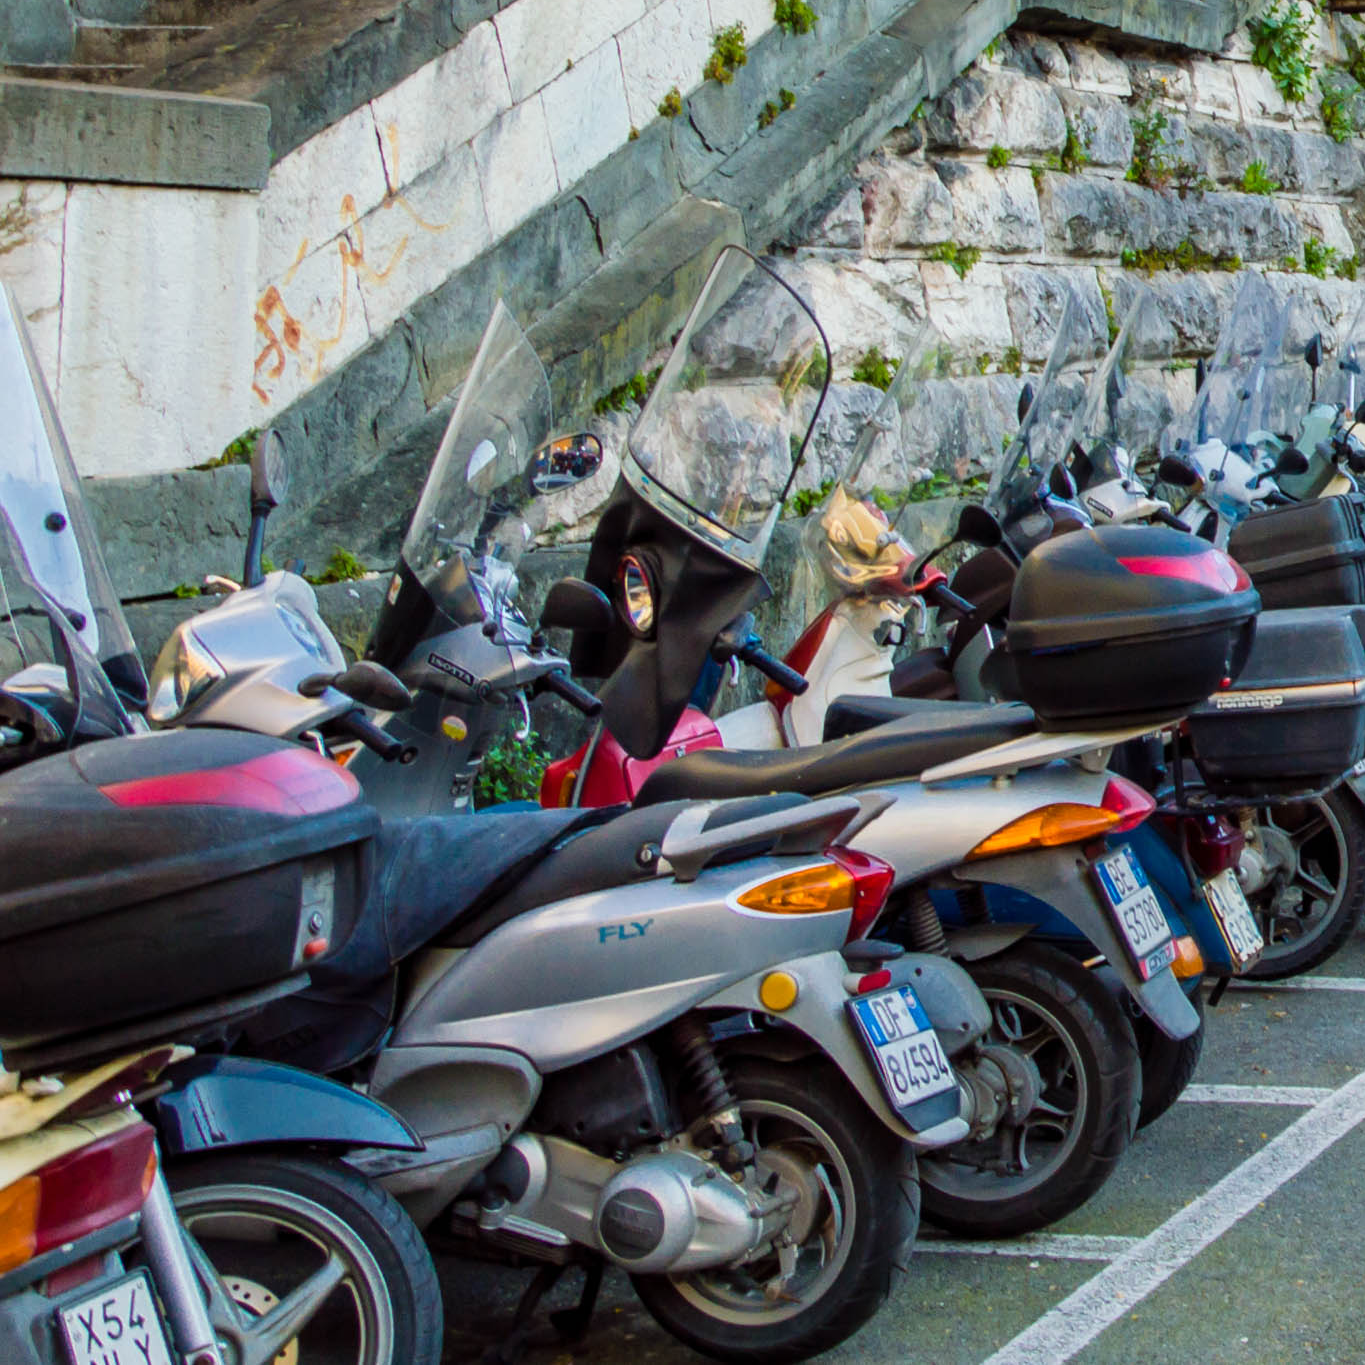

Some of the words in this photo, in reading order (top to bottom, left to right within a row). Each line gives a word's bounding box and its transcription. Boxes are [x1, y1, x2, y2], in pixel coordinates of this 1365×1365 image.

[1106, 857, 1135, 896] BE
[598, 918, 655, 944] FLY
[1123, 895, 1166, 946] 53780
[871, 997, 904, 1041] DF
[886, 1038, 949, 1095] 84594
[78, 1289, 146, 1354] X54
